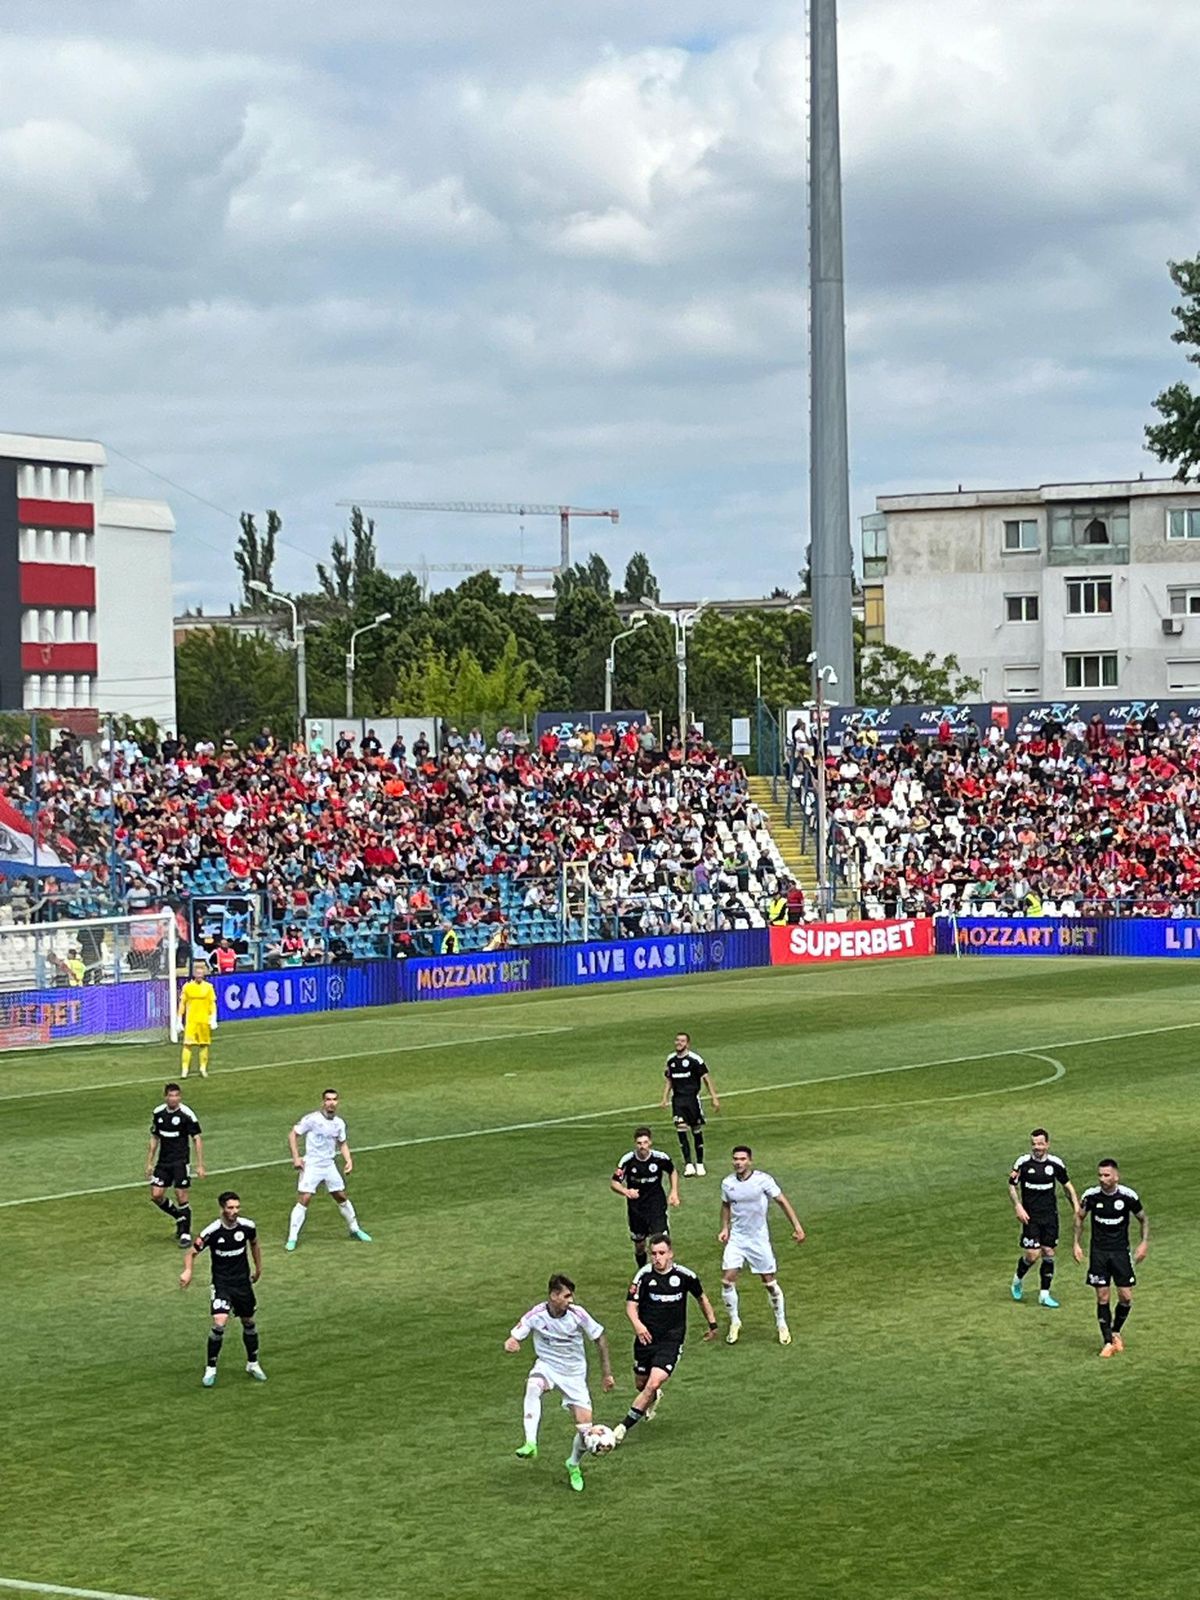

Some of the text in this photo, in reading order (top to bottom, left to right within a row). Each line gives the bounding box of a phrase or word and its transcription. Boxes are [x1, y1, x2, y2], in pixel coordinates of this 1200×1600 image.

[789, 921, 915, 957] SUPERBET
[951, 926, 1096, 947] MOZZART BET
[417, 959, 529, 991] MOZZART BET
[577, 940, 724, 975] LIVE CASINO
[225, 975, 344, 1010] CASINO
